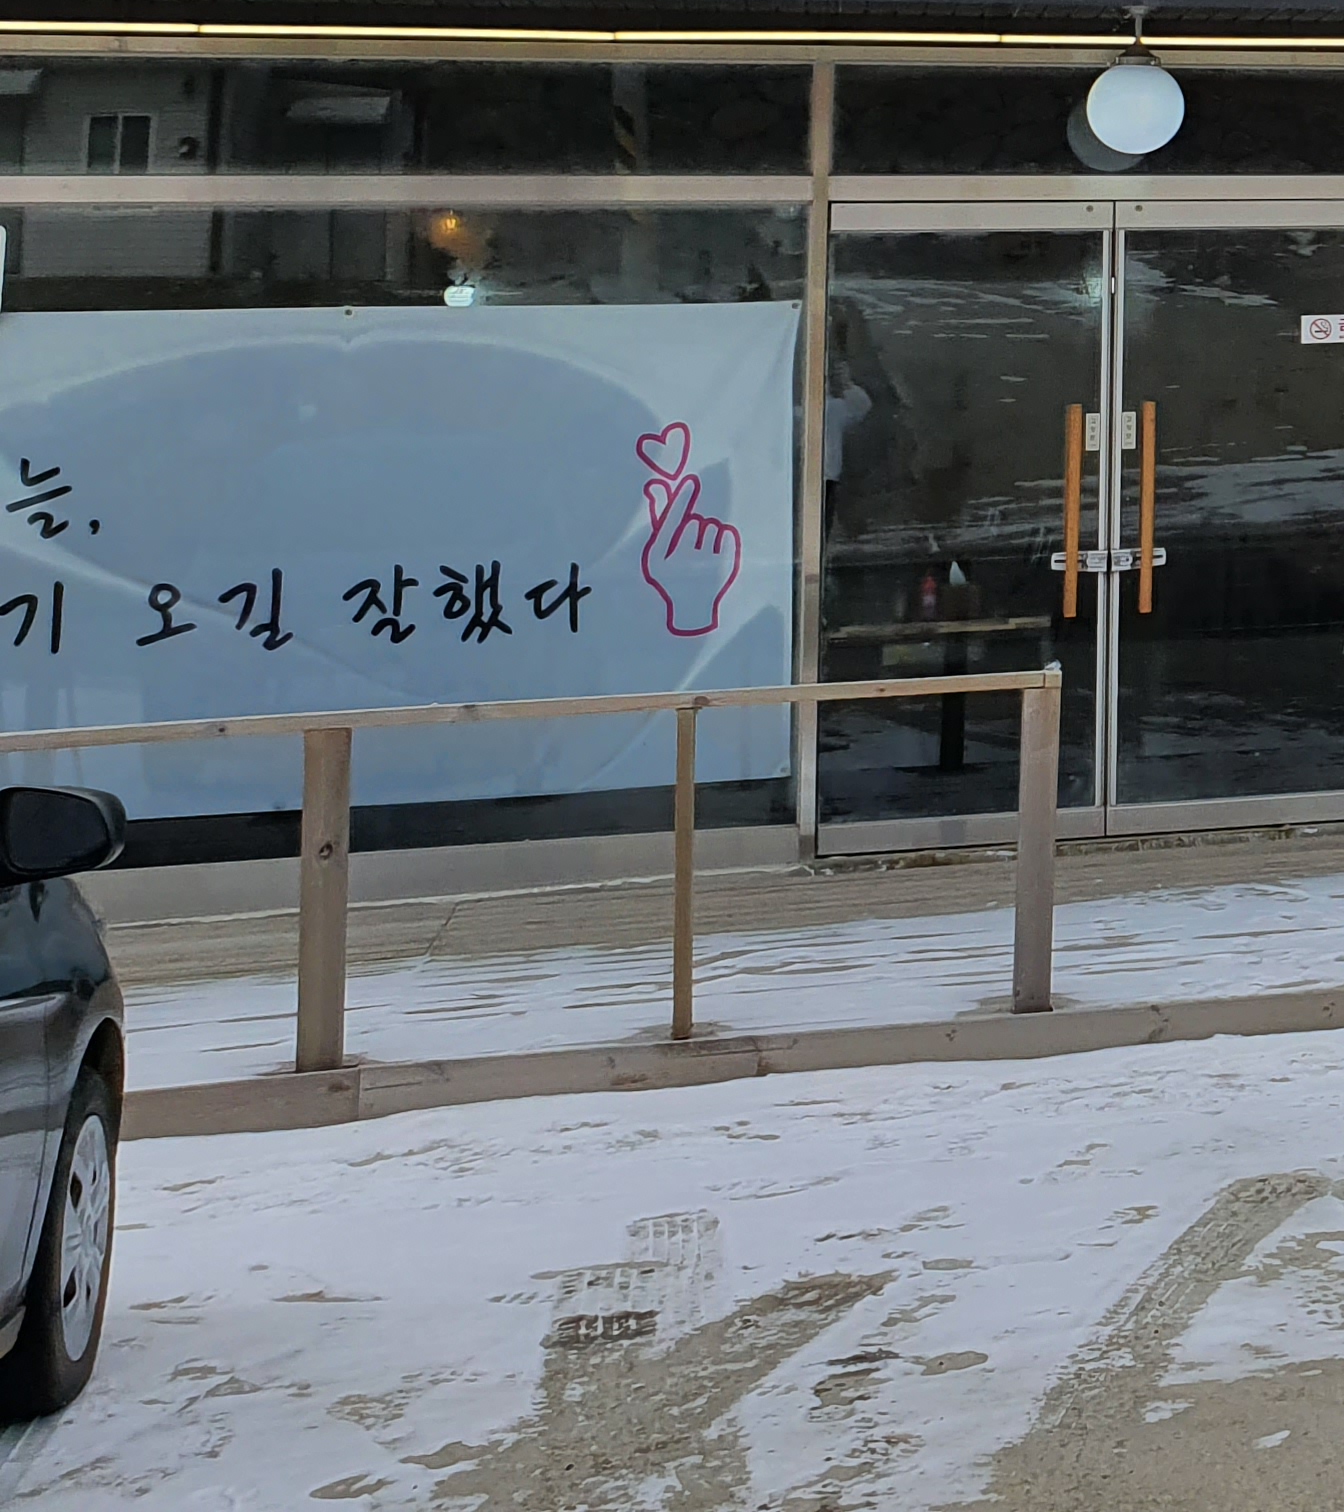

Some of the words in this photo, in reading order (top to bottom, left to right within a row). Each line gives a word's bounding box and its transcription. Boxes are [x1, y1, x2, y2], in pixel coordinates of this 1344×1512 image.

[6, 458, 101, 538] 늘,
[0, 581, 65, 654] 기
[136, 568, 293, 650] 오길
[342, 559, 591, 645] 잘했다
